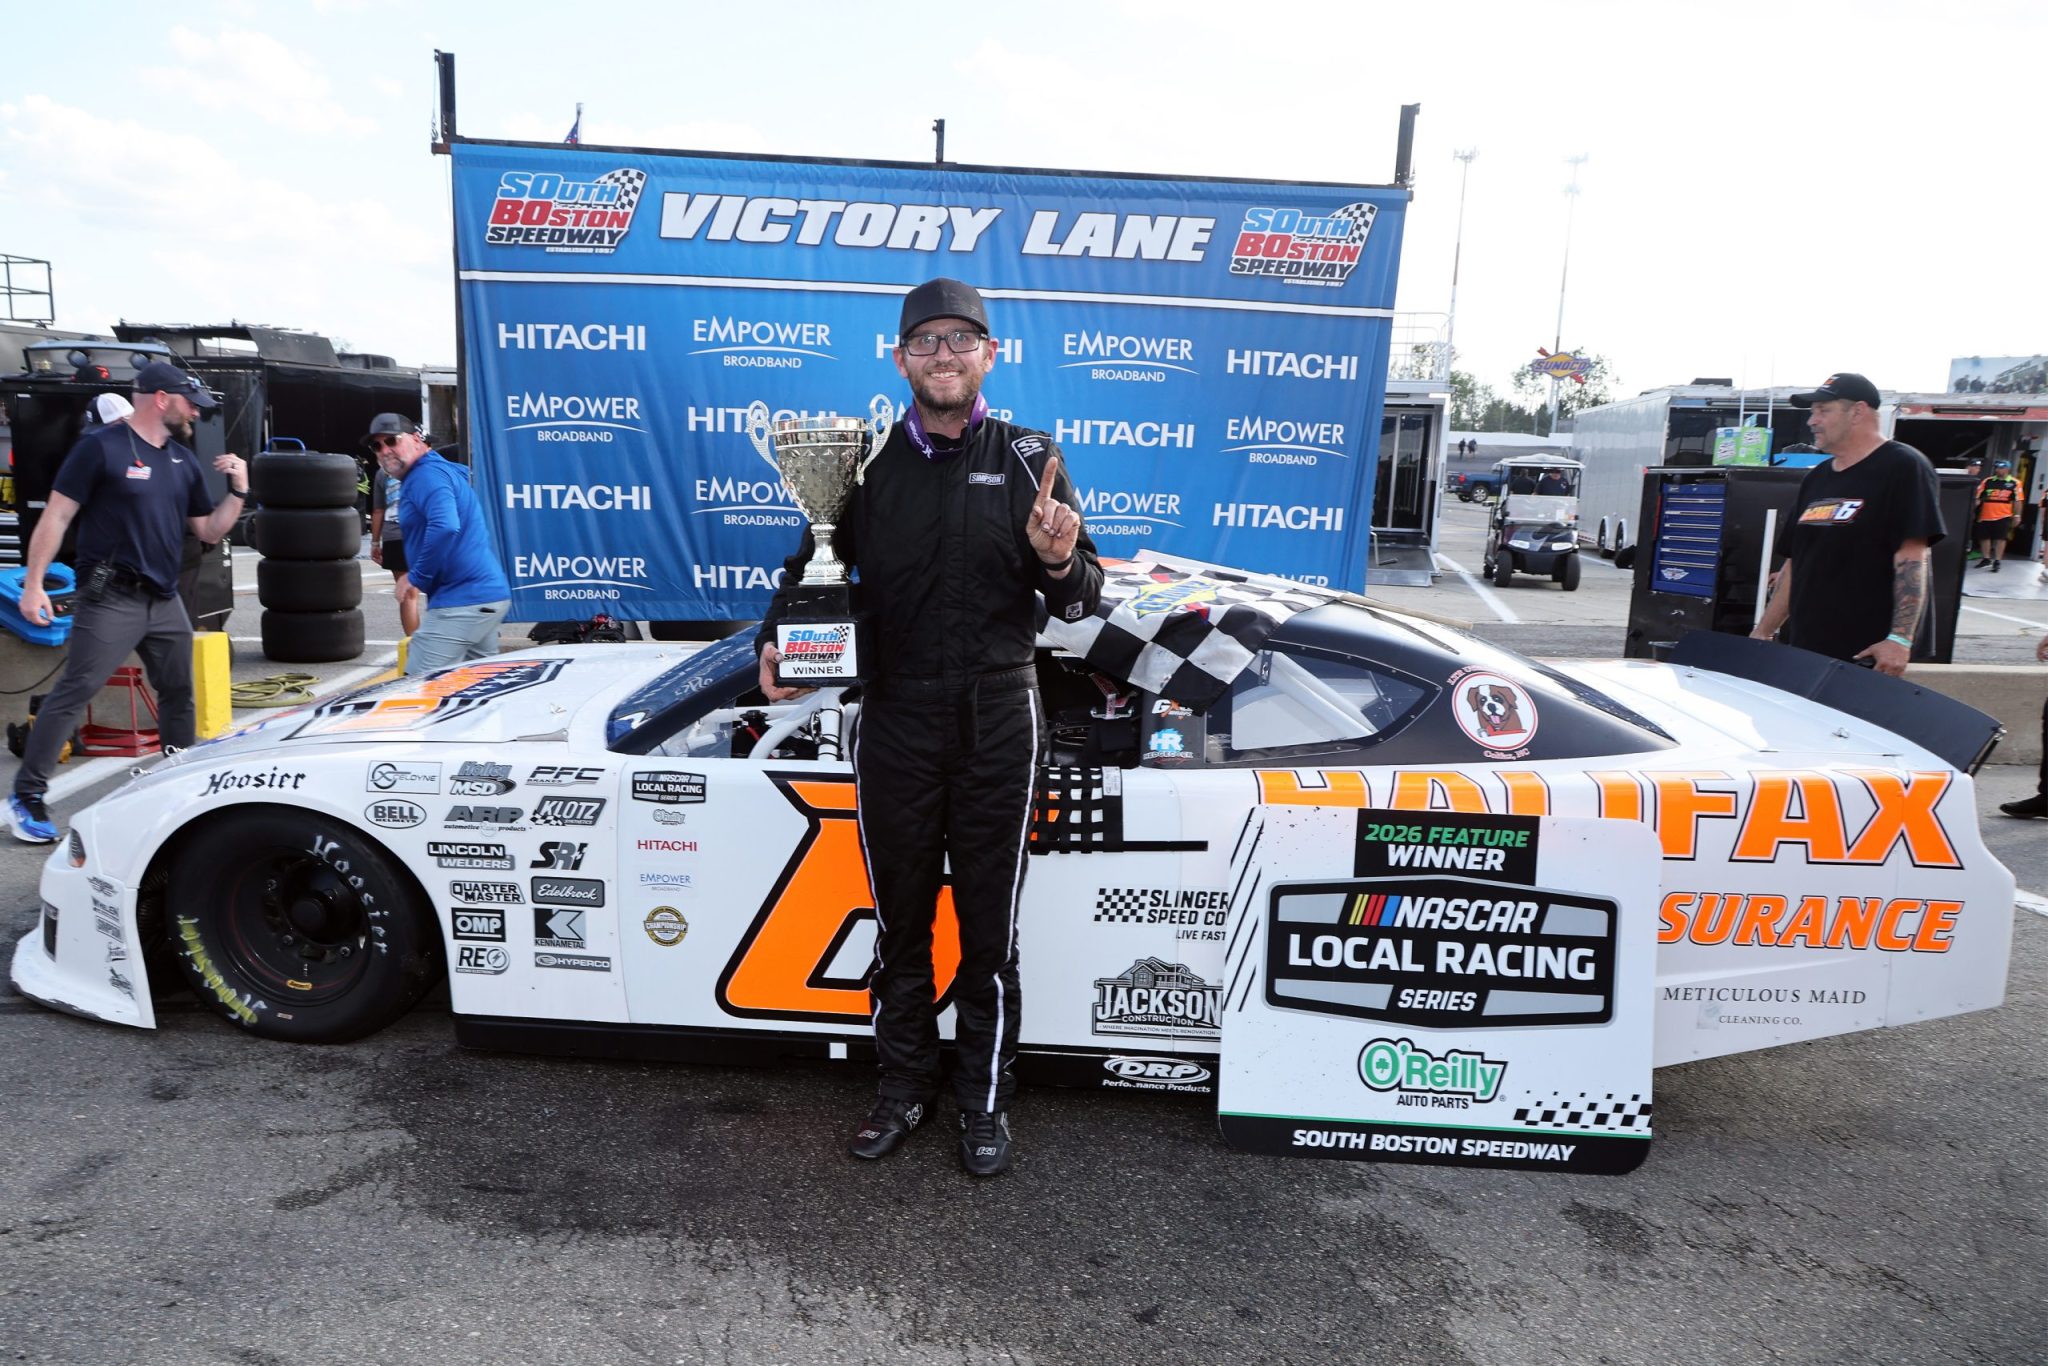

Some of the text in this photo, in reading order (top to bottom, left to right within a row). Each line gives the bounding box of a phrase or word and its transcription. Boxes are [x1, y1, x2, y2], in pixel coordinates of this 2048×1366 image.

[490, 199, 630, 229] BOSTON
[659, 191, 1217, 262] VICTORY LANE
[487, 226, 625, 245] SPEEDWAY
[1234, 232, 1361, 262] BOSTON
[1231, 257, 1356, 278] SPEEDWAY
[498, 323, 646, 351] HITACHI
[693, 315, 831, 346] EMPOWER
[1064, 330, 1194, 361] EMPOWER
[723, 354, 802, 369] BROADBAND
[1226, 349, 1358, 380] HITACHI
[1534, 359, 1590, 373] SUNOCO
[1091, 368, 1166, 383] BROADBAND
[507, 391, 640, 420] EMPOWER
[537, 430, 614, 443] BROADBAND
[1055, 418, 1194, 448] HITACHI
[1226, 415, 1344, 445] EMPOWER
[1249, 452, 1318, 466] BROADBAND
[972, 474, 1002, 483] SIMPSON
[506, 484, 651, 511] HITACHI
[695, 476, 795, 504] EMPOW
[1074, 487, 1181, 515] MPOWER
[723, 515, 801, 527] BROADBAND
[1213, 503, 1344, 532] HITACHI
[514, 552, 647, 579] EMPOWER
[545, 588, 620, 601] BROADBAND
[785, 642, 844, 653] BOSTON
[793, 666, 843, 675] WINNER
[1149, 733, 1184, 751] HR
[529, 765, 606, 780] PFC
[660, 774, 690, 783] NASCAR
[199, 766, 307, 797] Hoosier
[450, 780, 498, 795] MSD
[636, 783, 703, 794] LOCAL RACING
[373, 805, 419, 820] BELL
[443, 805, 524, 823] ARP
[540, 800, 601, 820] KLOTZ
[1364, 824, 1531, 849] 2026 FEATURE
[428, 844, 504, 857] LINCOLN
[637, 840, 697, 852] HITACHI
[441, 858, 512, 870] WELDERS
[1387, 844, 1506, 872] WINNER
[640, 873, 691, 884] EMPOWER
[452, 882, 518, 895] QUARTER
[537, 883, 599, 900] Edelbrock
[464, 892, 522, 903] MASTER
[1147, 909, 1199, 925] SPEED
[1394, 895, 1540, 934] NASCAR
[1658, 892, 1965, 954] SURANCE
[455, 917, 502, 932] OMP
[534, 939, 586, 949] KENNAMETAL
[556, 958, 611, 968] HYPERCO
[1289, 934, 1596, 981] LOCAL RACING
[1398, 988, 1478, 1012] SERIES
[1663, 986, 1867, 1005] METICULOUS MAID
[1096, 984, 1223, 1028] JACKSON
[1122, 1014, 1195, 1027] CONSTRUCTION
[1718, 1014, 1781, 1026] CLEANING
[1118, 1061, 1199, 1078] DRP
[1363, 1042, 1501, 1097] O'Reilly
[1168, 1083, 1212, 1093] Products
[1397, 1095, 1470, 1110] AUTO PARTS
[1292, 1129, 1577, 1163] SOUTH BOSTON SPEEDWAY
